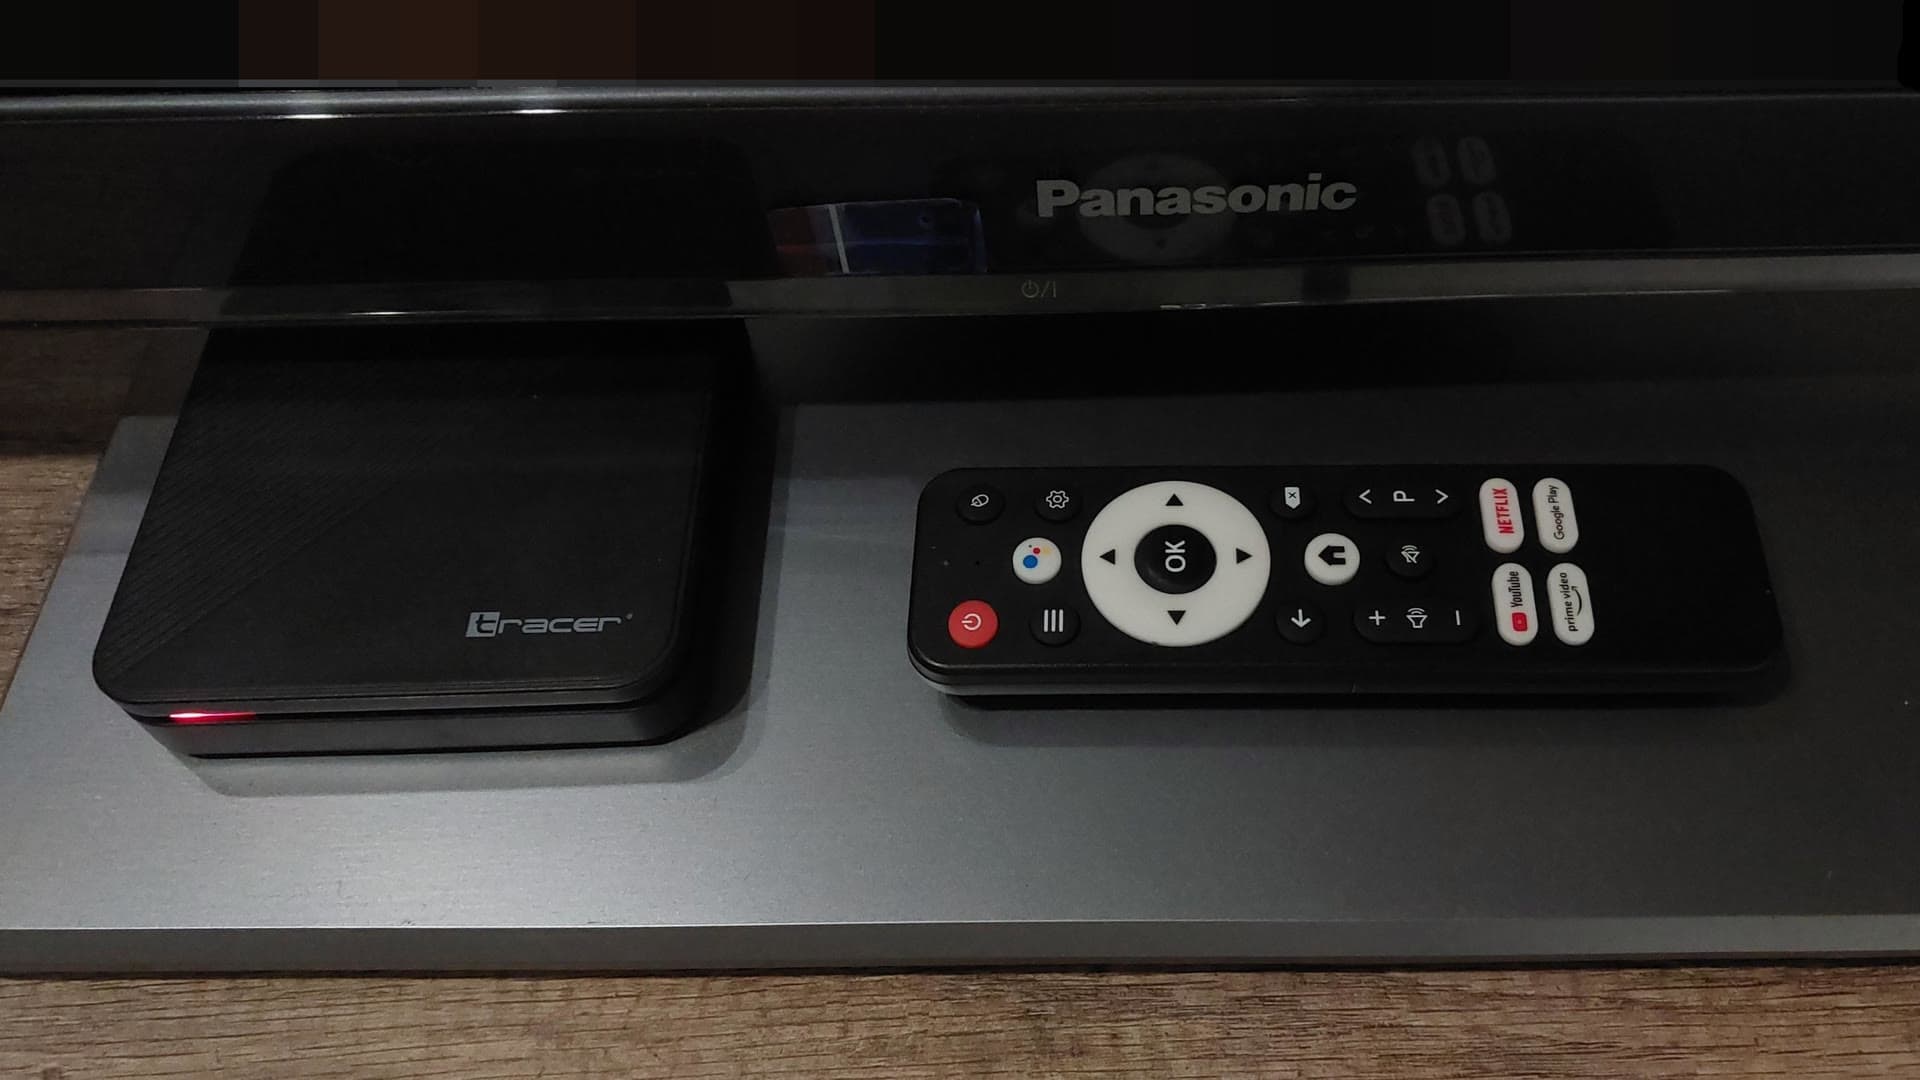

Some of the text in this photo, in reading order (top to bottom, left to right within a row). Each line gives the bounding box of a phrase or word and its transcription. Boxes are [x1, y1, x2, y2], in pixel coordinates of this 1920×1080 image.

[1035, 172, 1358, 218] Panasonic
[1392, 490, 1416, 503] P
[1492, 487, 1515, 534] NETFLIX
[1547, 484, 1566, 540] Google Play
[1164, 540, 1186, 573] OK
[1508, 570, 1522, 608] YouTube
[1559, 571, 1579, 632] prime video
[465, 611, 623, 638] tracer
